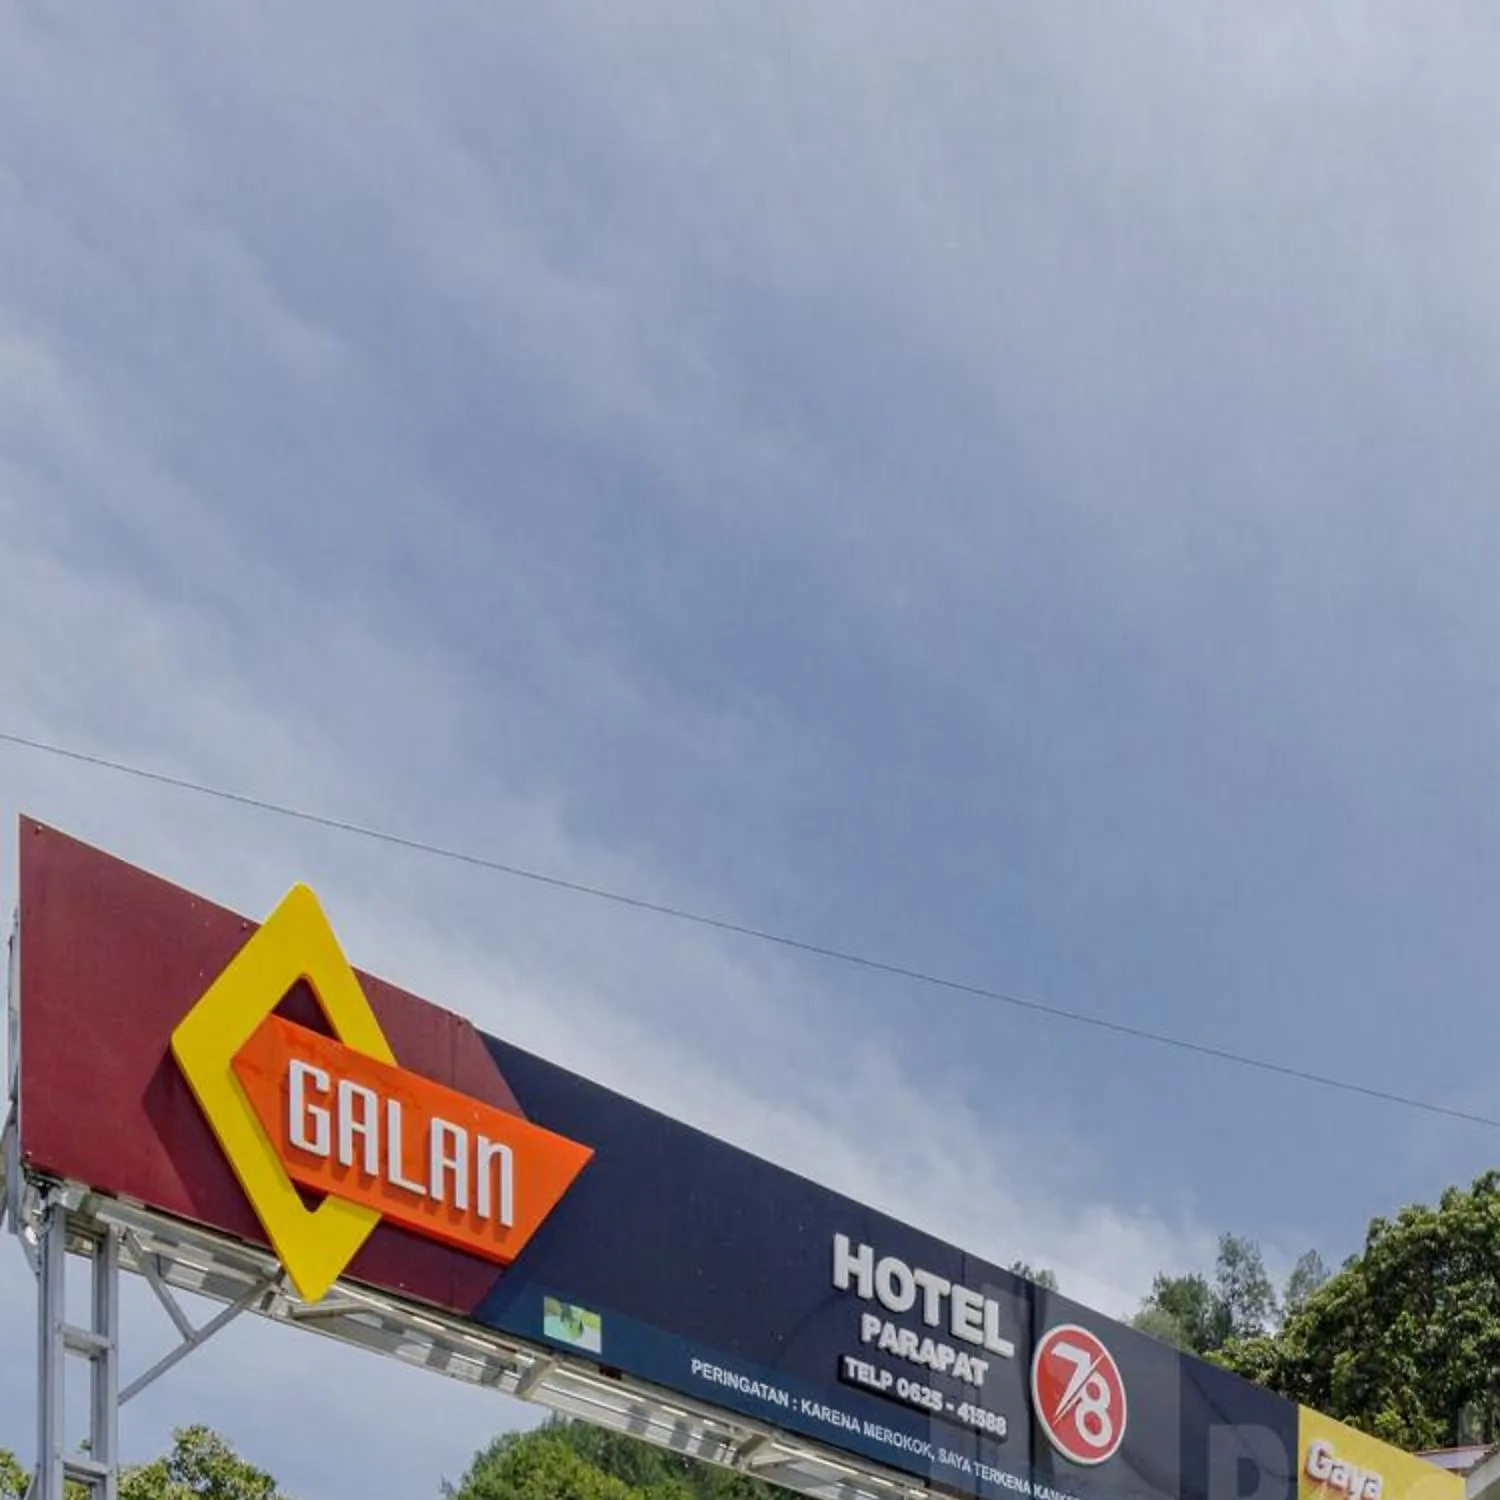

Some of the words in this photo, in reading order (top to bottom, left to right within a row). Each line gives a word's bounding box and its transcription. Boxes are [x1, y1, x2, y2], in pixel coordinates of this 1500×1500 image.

[289, 1059, 514, 1228] GALAN
[832, 1231, 1016, 1359] HOTEL
[860, 1313, 989, 1387] PARAPAT
[690, 1358, 790, 1407] PERINGATAN
[800, 1399, 861, 1433] KARENA
[863, 1422, 937, 1461] MEROKOK,
[937, 1446, 973, 1474] SAYA
[973, 1460, 1032, 1496] TERKENA
[844, 1355, 894, 1391] TELP
[895, 1378, 944, 1411] 0625
[956, 1403, 1008, 1436] 41588
[1052, 1341, 1113, 1448] 78
